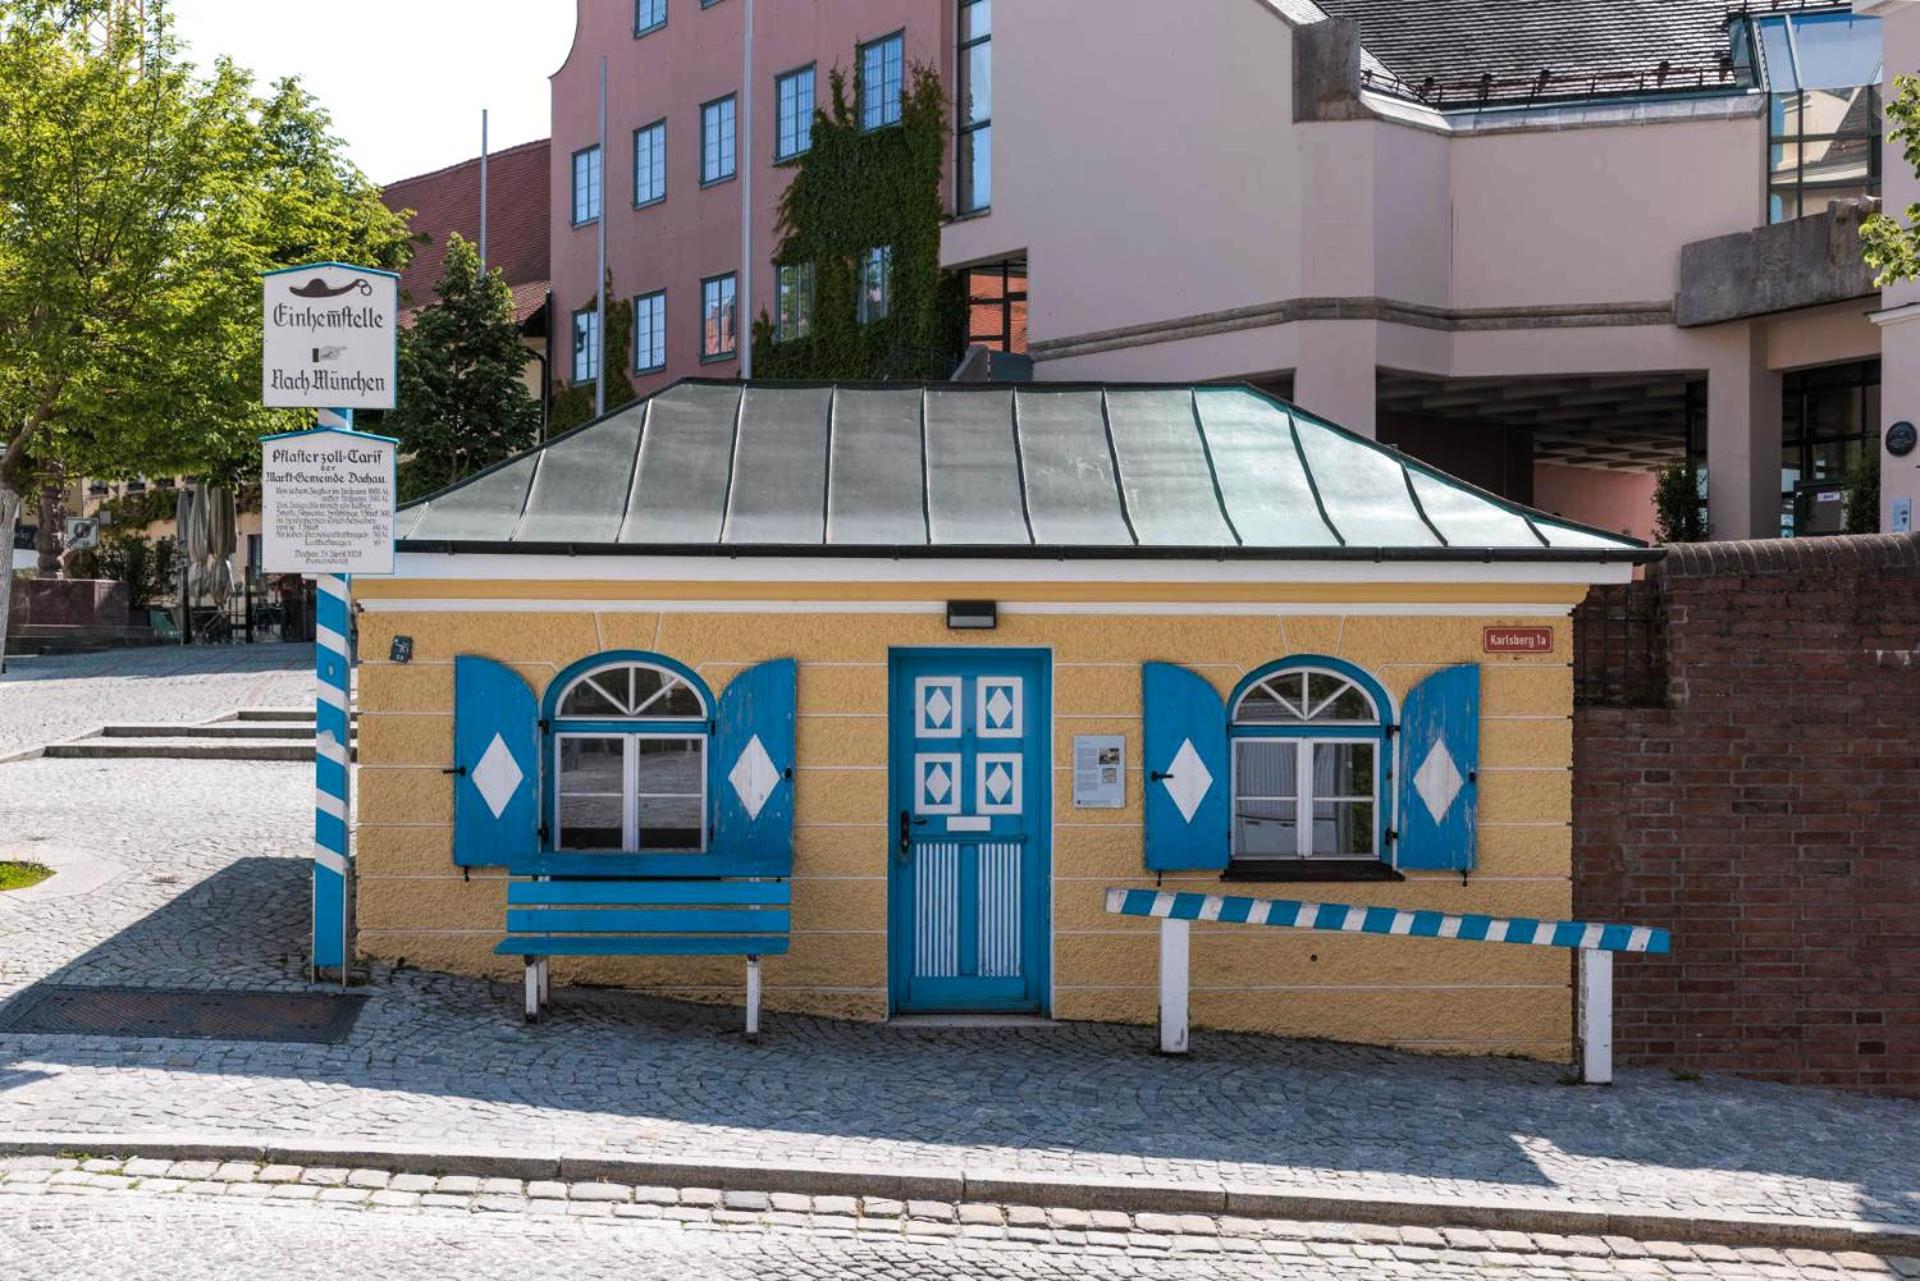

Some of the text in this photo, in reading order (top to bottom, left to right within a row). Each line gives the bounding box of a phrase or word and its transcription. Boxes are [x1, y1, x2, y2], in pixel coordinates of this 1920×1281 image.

[271, 369, 385, 396] Nach München
[1490, 634, 1546, 648] Karlsberg 1a
